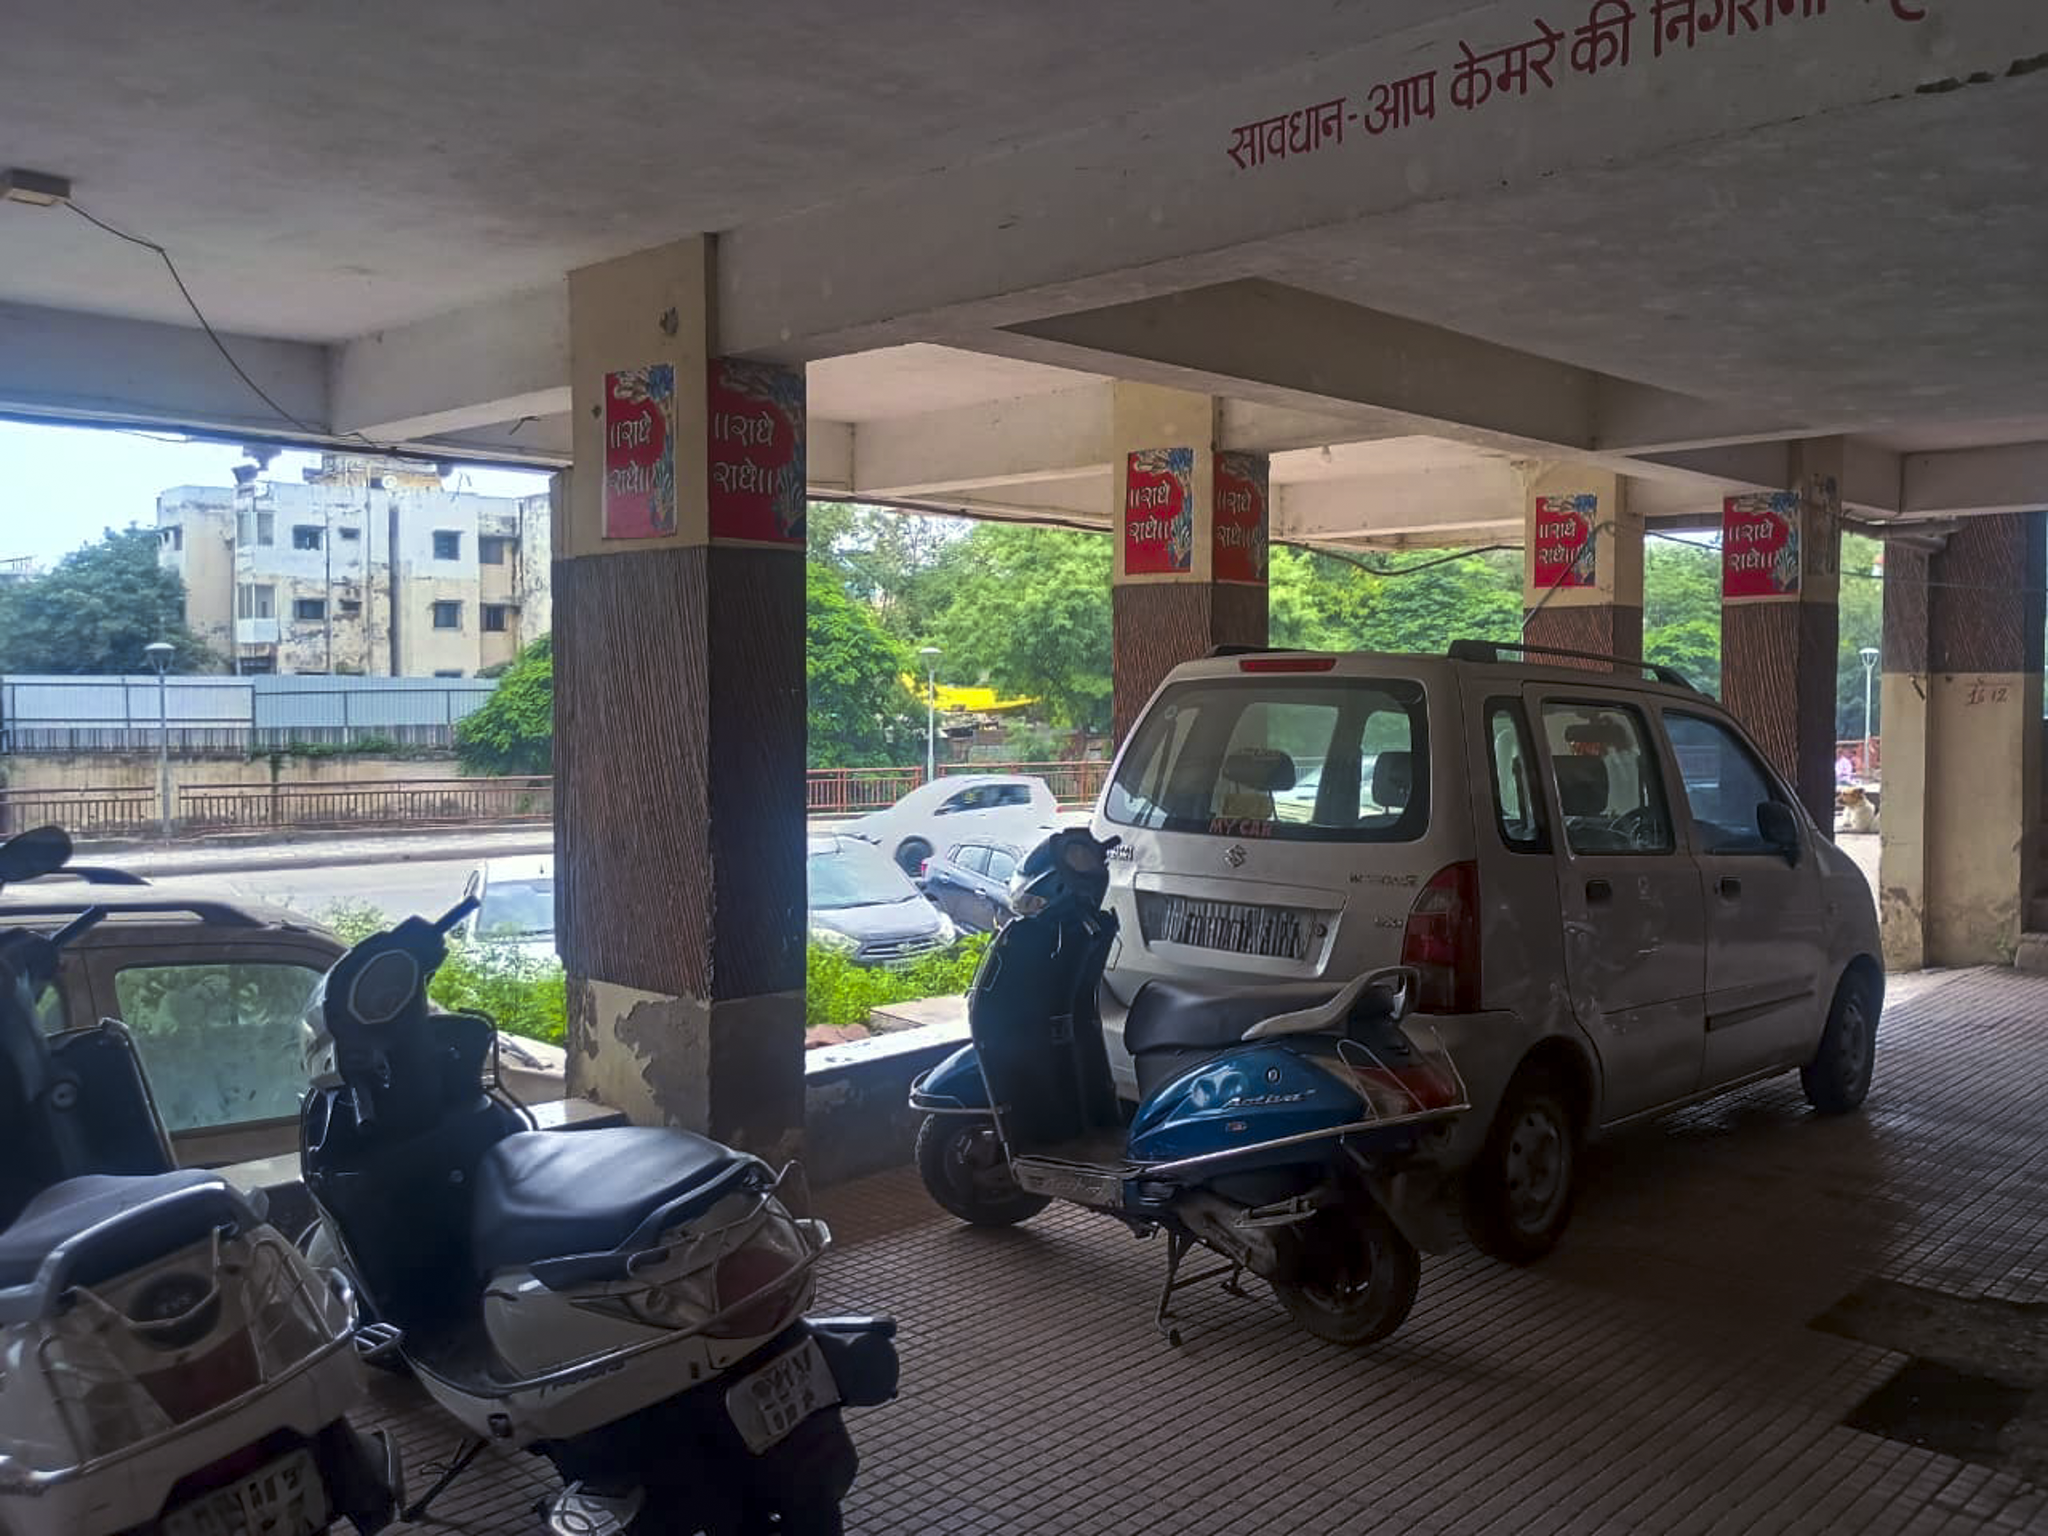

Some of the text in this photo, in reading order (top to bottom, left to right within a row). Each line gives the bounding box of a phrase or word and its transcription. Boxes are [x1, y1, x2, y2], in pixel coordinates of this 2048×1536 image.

[1570, 0, 1637, 74] की
[1208, 818, 1273, 837] MY CAR
